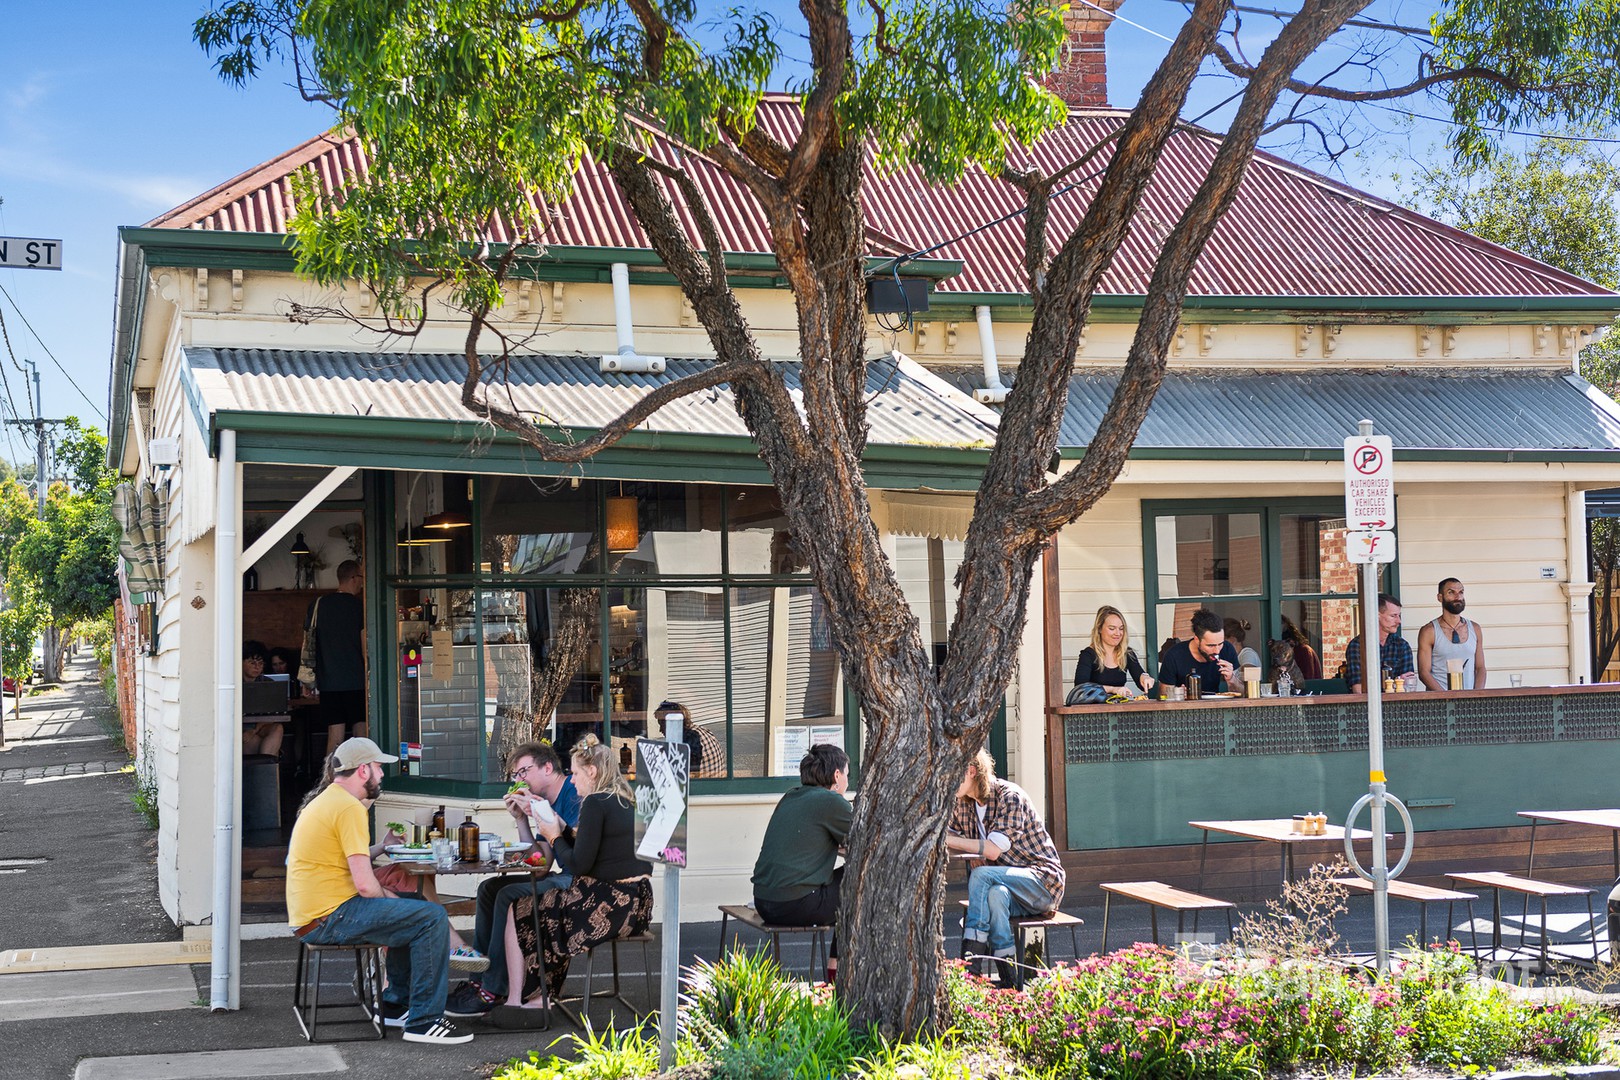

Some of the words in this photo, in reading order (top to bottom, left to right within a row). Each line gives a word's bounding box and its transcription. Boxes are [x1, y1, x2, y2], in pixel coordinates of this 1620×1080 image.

[25, 241, 57, 265] ST
[1350, 478, 1390, 488] AUTHORISED
[1351, 488, 1365, 498] CAR
[1366, 488, 1388, 497] SHARE
[1354, 498, 1386, 507] VEHICLES
[1354, 507, 1387, 517] EXCEPTED
